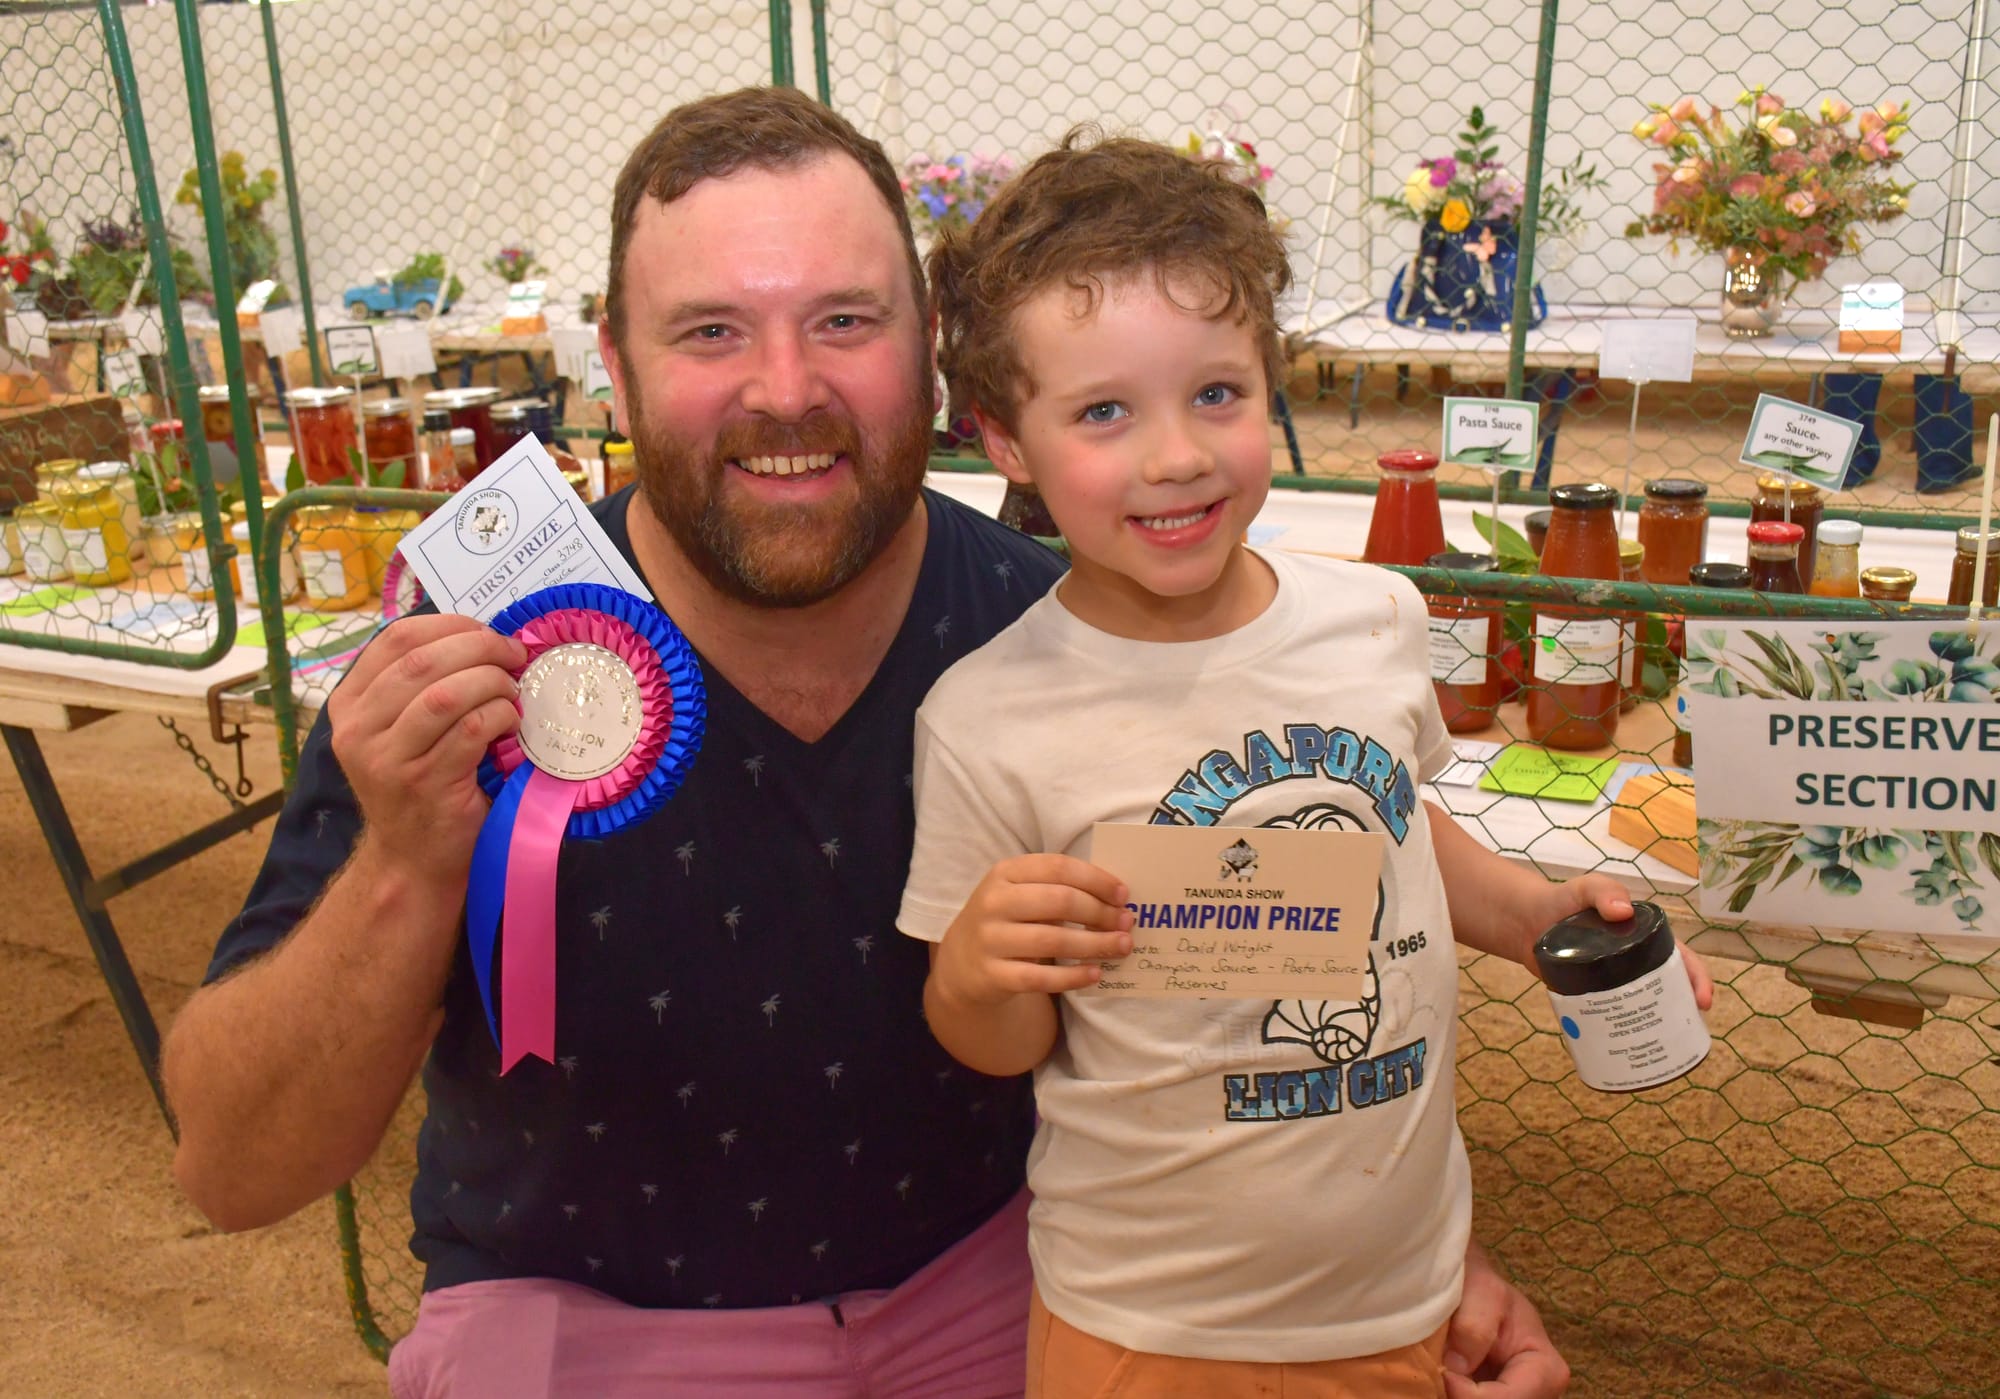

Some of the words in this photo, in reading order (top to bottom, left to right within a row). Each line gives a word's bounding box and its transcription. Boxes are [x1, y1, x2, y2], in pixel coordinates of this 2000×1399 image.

[1459, 415, 1488, 428] Pasta
[1491, 417, 1523, 431] Sauce
[1785, 422, 1821, 441] Sauce-
[1764, 432, 1779, 444] any
[1780, 437, 1804, 450] other
[1805, 445, 1833, 462] variety
[457, 495, 479, 530] TANUNDA
[479, 490, 502, 501] SHOW
[468, 560, 514, 607] FIRST
[513, 518, 563, 566] PRIZE
[543, 562, 561, 577] Class
[558, 537, 584, 561] 3748
[537, 718, 605, 748] CHAMPION
[1769, 714, 2000, 752] PRESERVE
[1795, 772, 1996, 812] SECTION
[1184, 887, 1243, 899] TANUNDA
[1246, 888, 1285, 900] SHOW
[1268, 905, 1341, 932] PRIZE
[1176, 938, 1218, 954] David
[1223, 939, 1274, 958] Wright
[1386, 931, 1427, 961] 1965
[1138, 958, 1201, 975] Champion
[1211, 958, 1258, 974] Sauce
[1321, 959, 1359, 975] Sauce
[1164, 976, 1229, 991] Preserves
[1586, 994, 1623, 1007] Tanunda
[1623, 988, 1645, 999] Show
[1608, 1027, 1631, 1039] OPEN
[1631, 1017, 1663, 1034] SECTION
[1613, 1011, 1657, 1030] PRESERVES
[1224, 1063, 1343, 1122] LION
[1347, 1036, 1427, 1110] CITY
